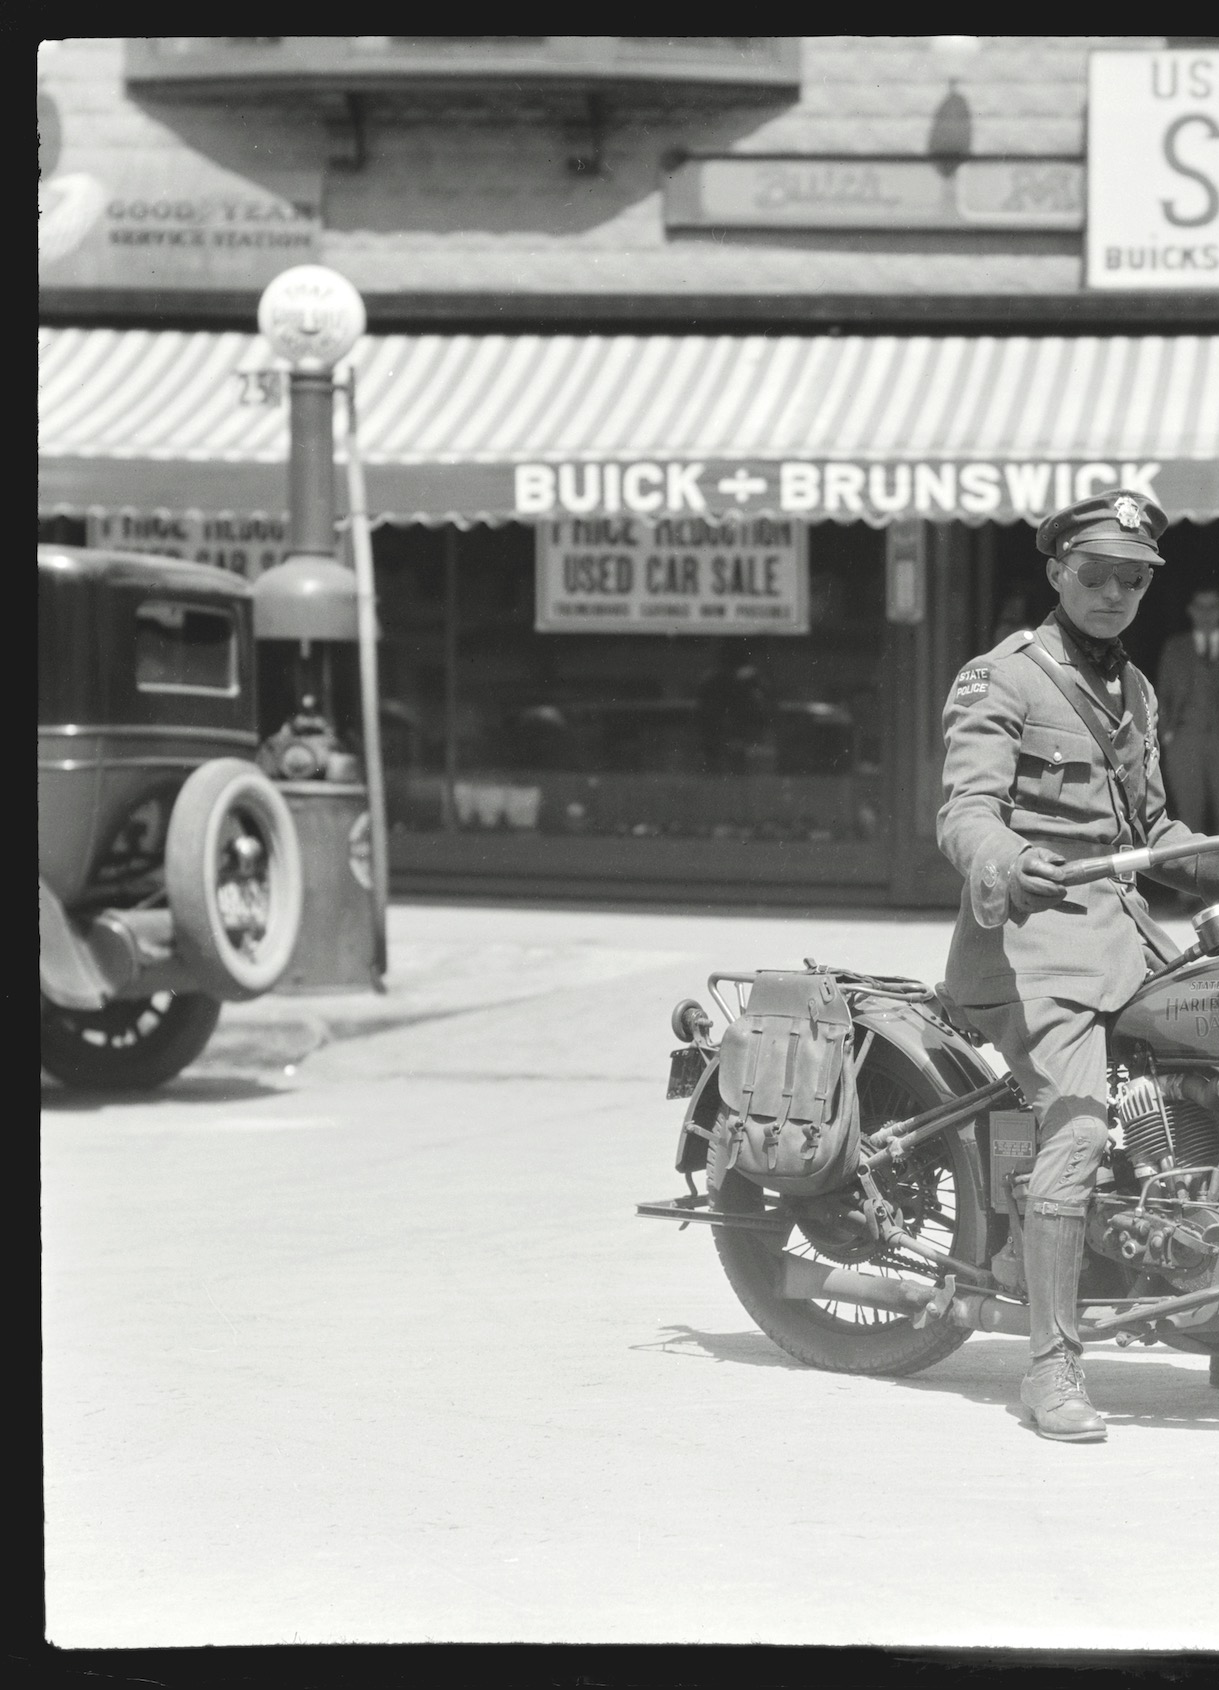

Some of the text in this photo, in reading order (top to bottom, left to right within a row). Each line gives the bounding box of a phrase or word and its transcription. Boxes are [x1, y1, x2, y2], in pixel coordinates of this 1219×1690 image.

[514, 462, 705, 513] BUICK
[779, 462, 1163, 513] BRUNSWICK
[563, 555, 781, 597] USED CAR SALE
[959, 668, 988, 682] STATE
[956, 682, 988, 697] POLICE
